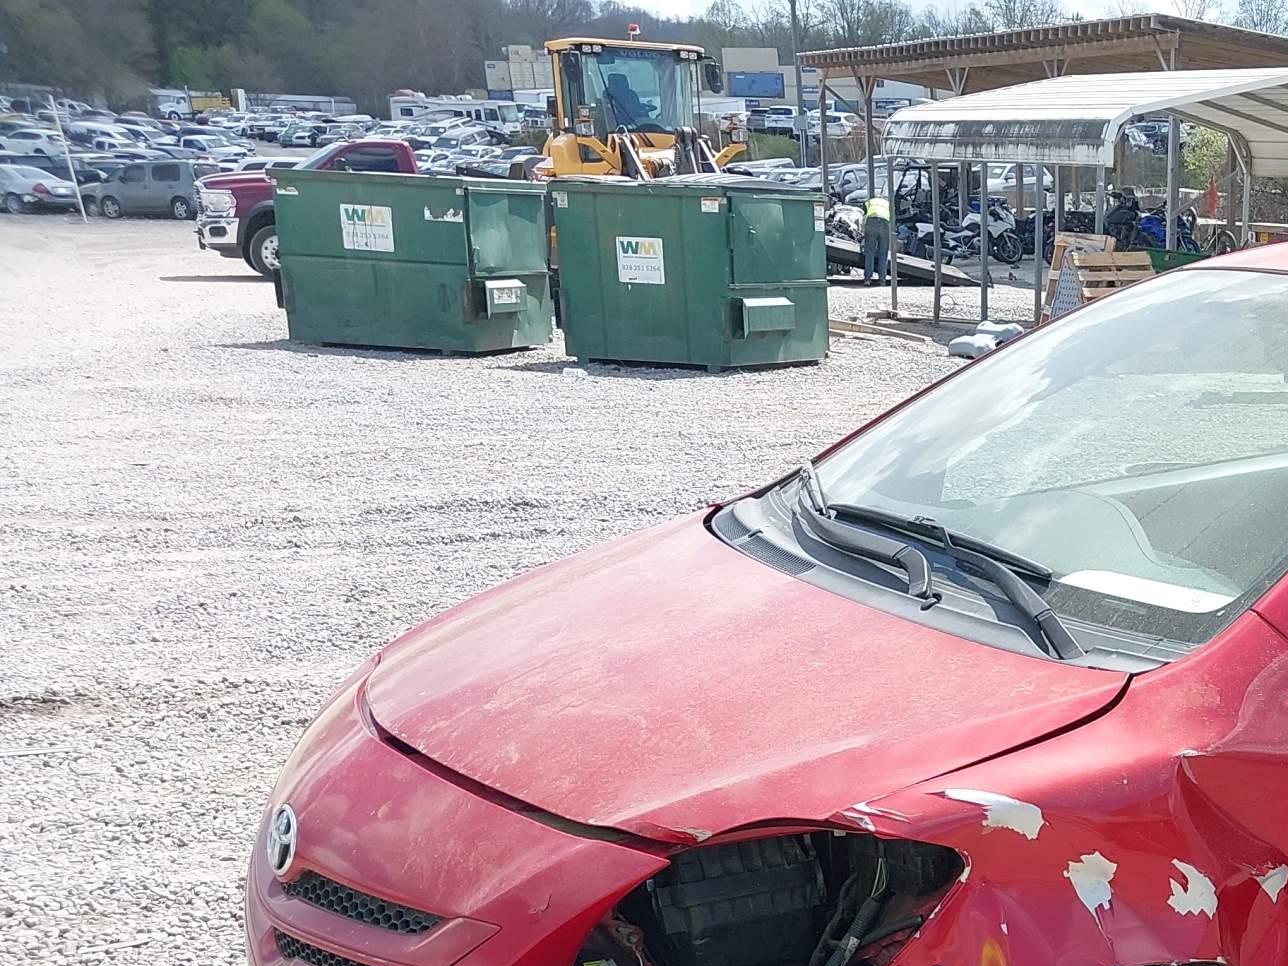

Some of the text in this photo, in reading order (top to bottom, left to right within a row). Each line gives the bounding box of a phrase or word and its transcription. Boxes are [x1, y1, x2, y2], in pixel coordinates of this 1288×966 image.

[620, 49, 660, 58] VOLVO
[344, 208, 386, 224] WM
[620, 241, 658, 255] WM
